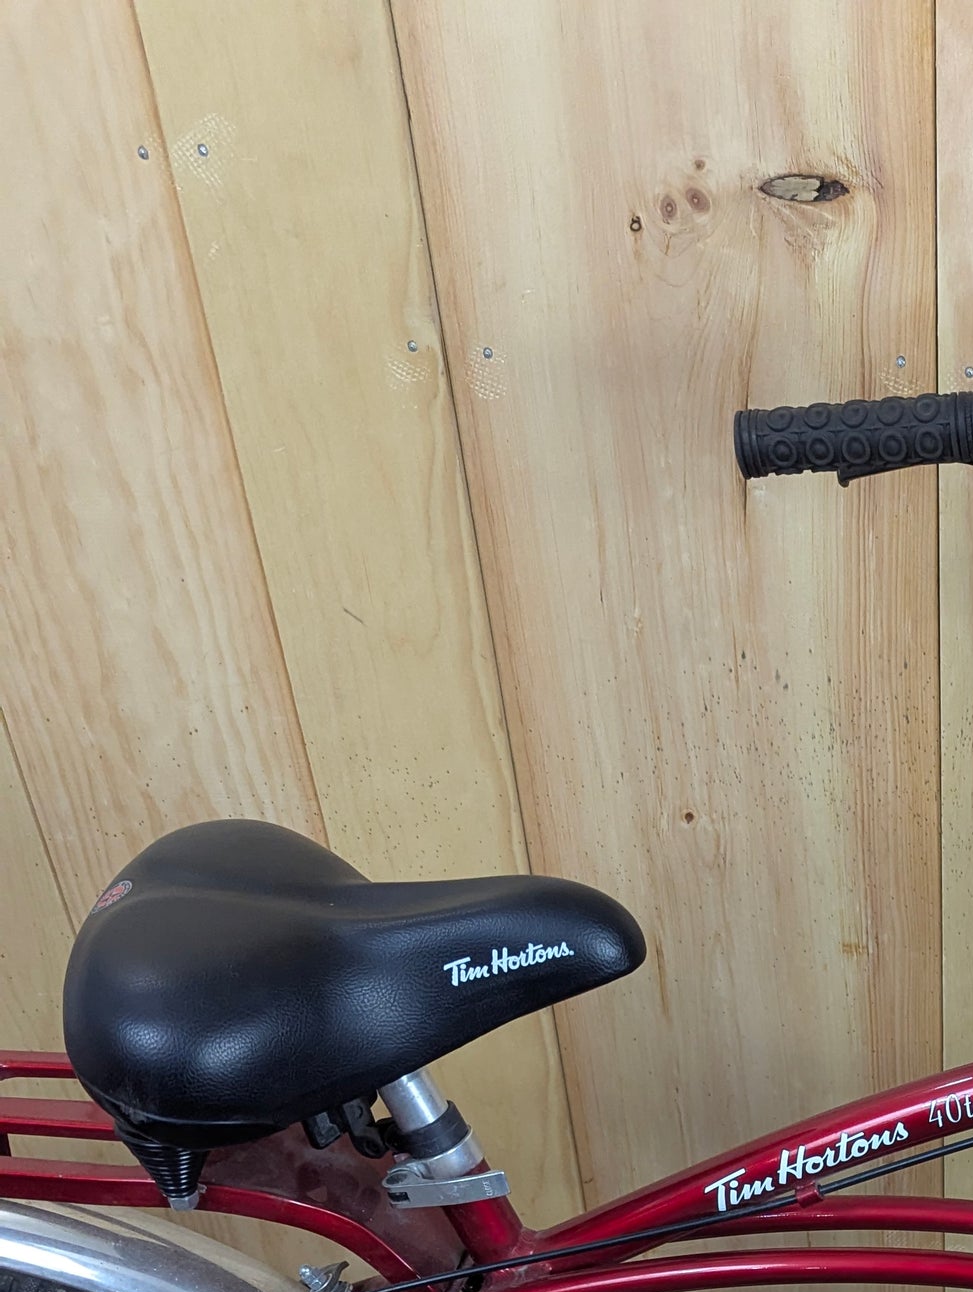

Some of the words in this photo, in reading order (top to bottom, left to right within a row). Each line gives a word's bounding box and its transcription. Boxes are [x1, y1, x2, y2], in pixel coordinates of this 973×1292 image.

[443, 956, 490, 986] Tim
[704, 1168, 775, 1212] Tim
[777, 1121, 909, 1185] Hortons
